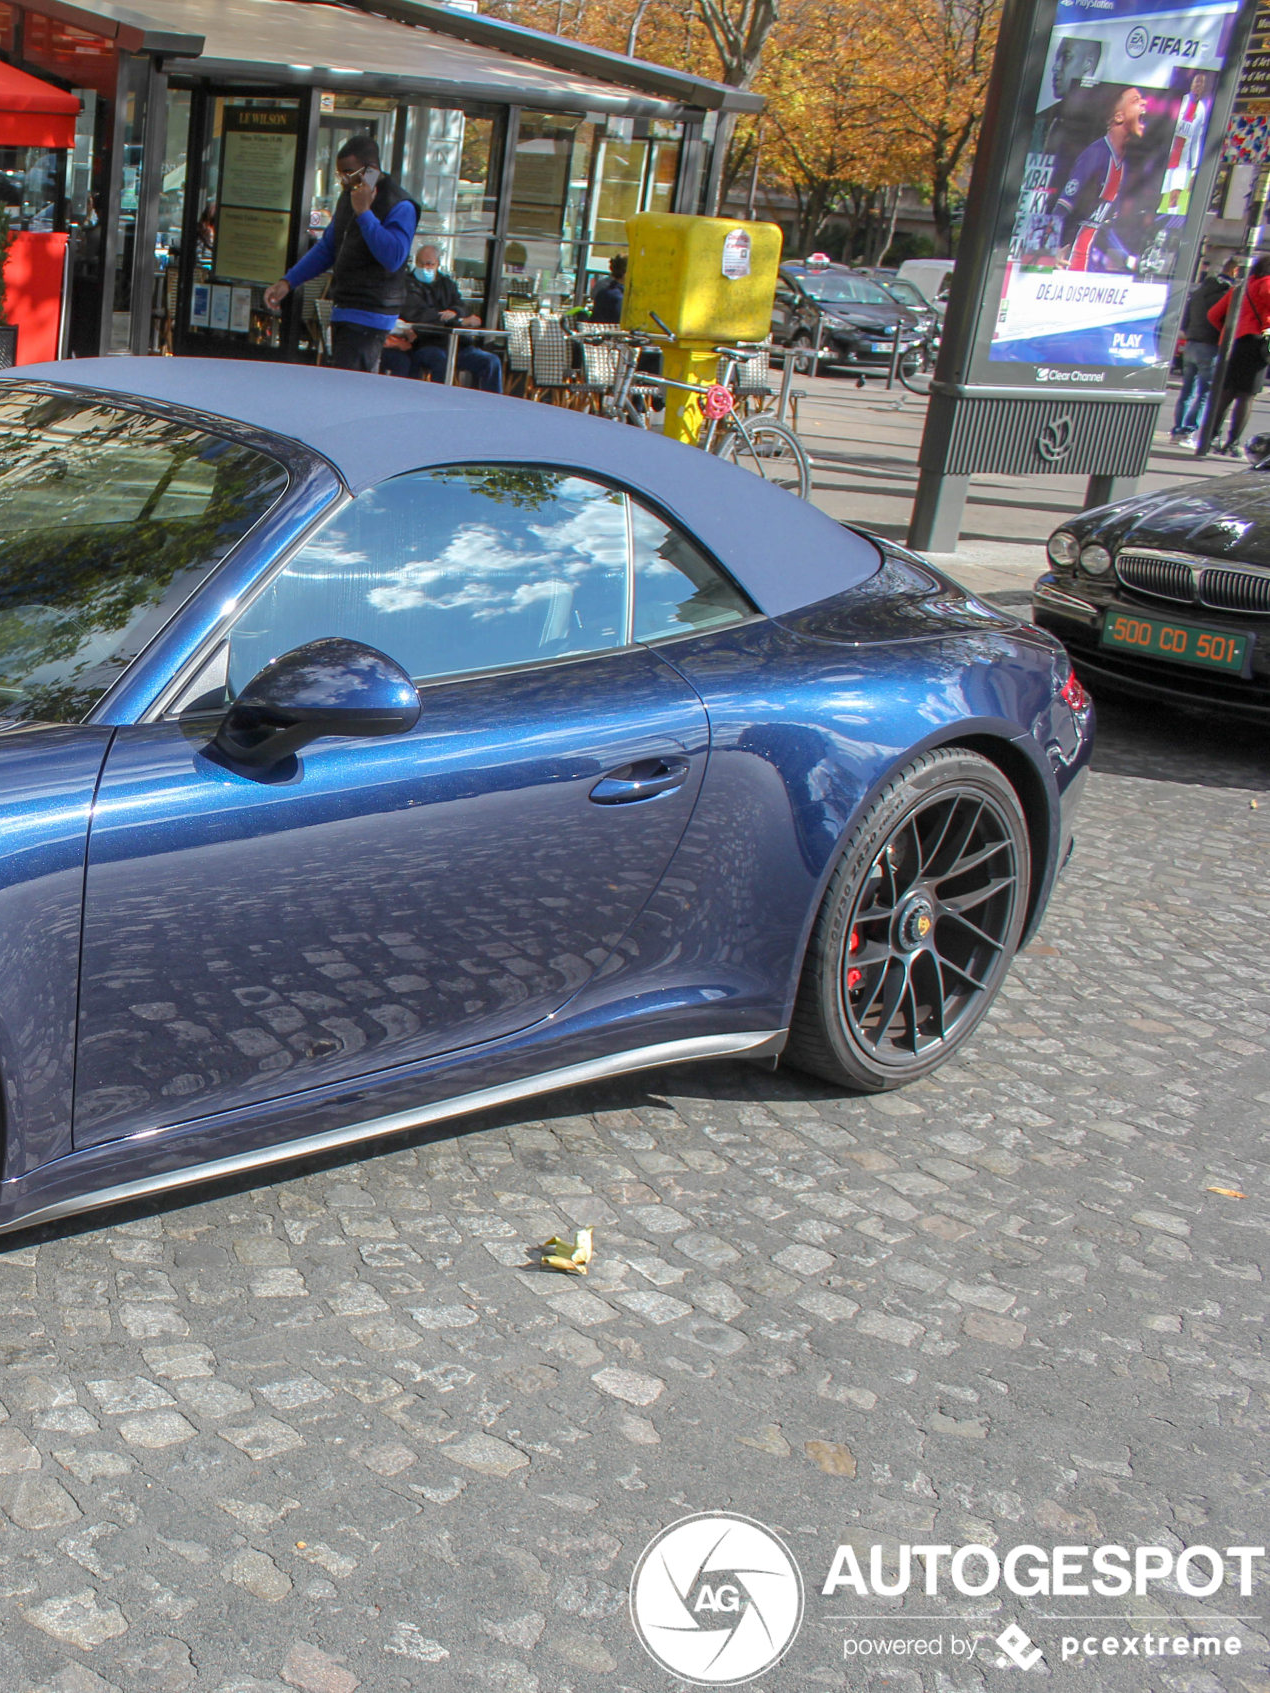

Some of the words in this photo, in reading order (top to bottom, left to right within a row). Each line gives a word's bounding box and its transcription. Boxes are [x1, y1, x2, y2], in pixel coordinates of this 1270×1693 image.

[1148, 35, 1182, 57] FIFA
[1183, 39, 1201, 58] 21
[251, 112, 287, 125] WILSON
[1065, 285, 1129, 305] DISPONIBLE
[1112, 333, 1144, 348] PLAY
[1049, 369, 1070, 381] Clear
[1071, 370, 1105, 382] Channel
[1113, 618, 1152, 646] 500
[1159, 627, 1188, 653] CD
[1195, 634, 1236, 662] 501
